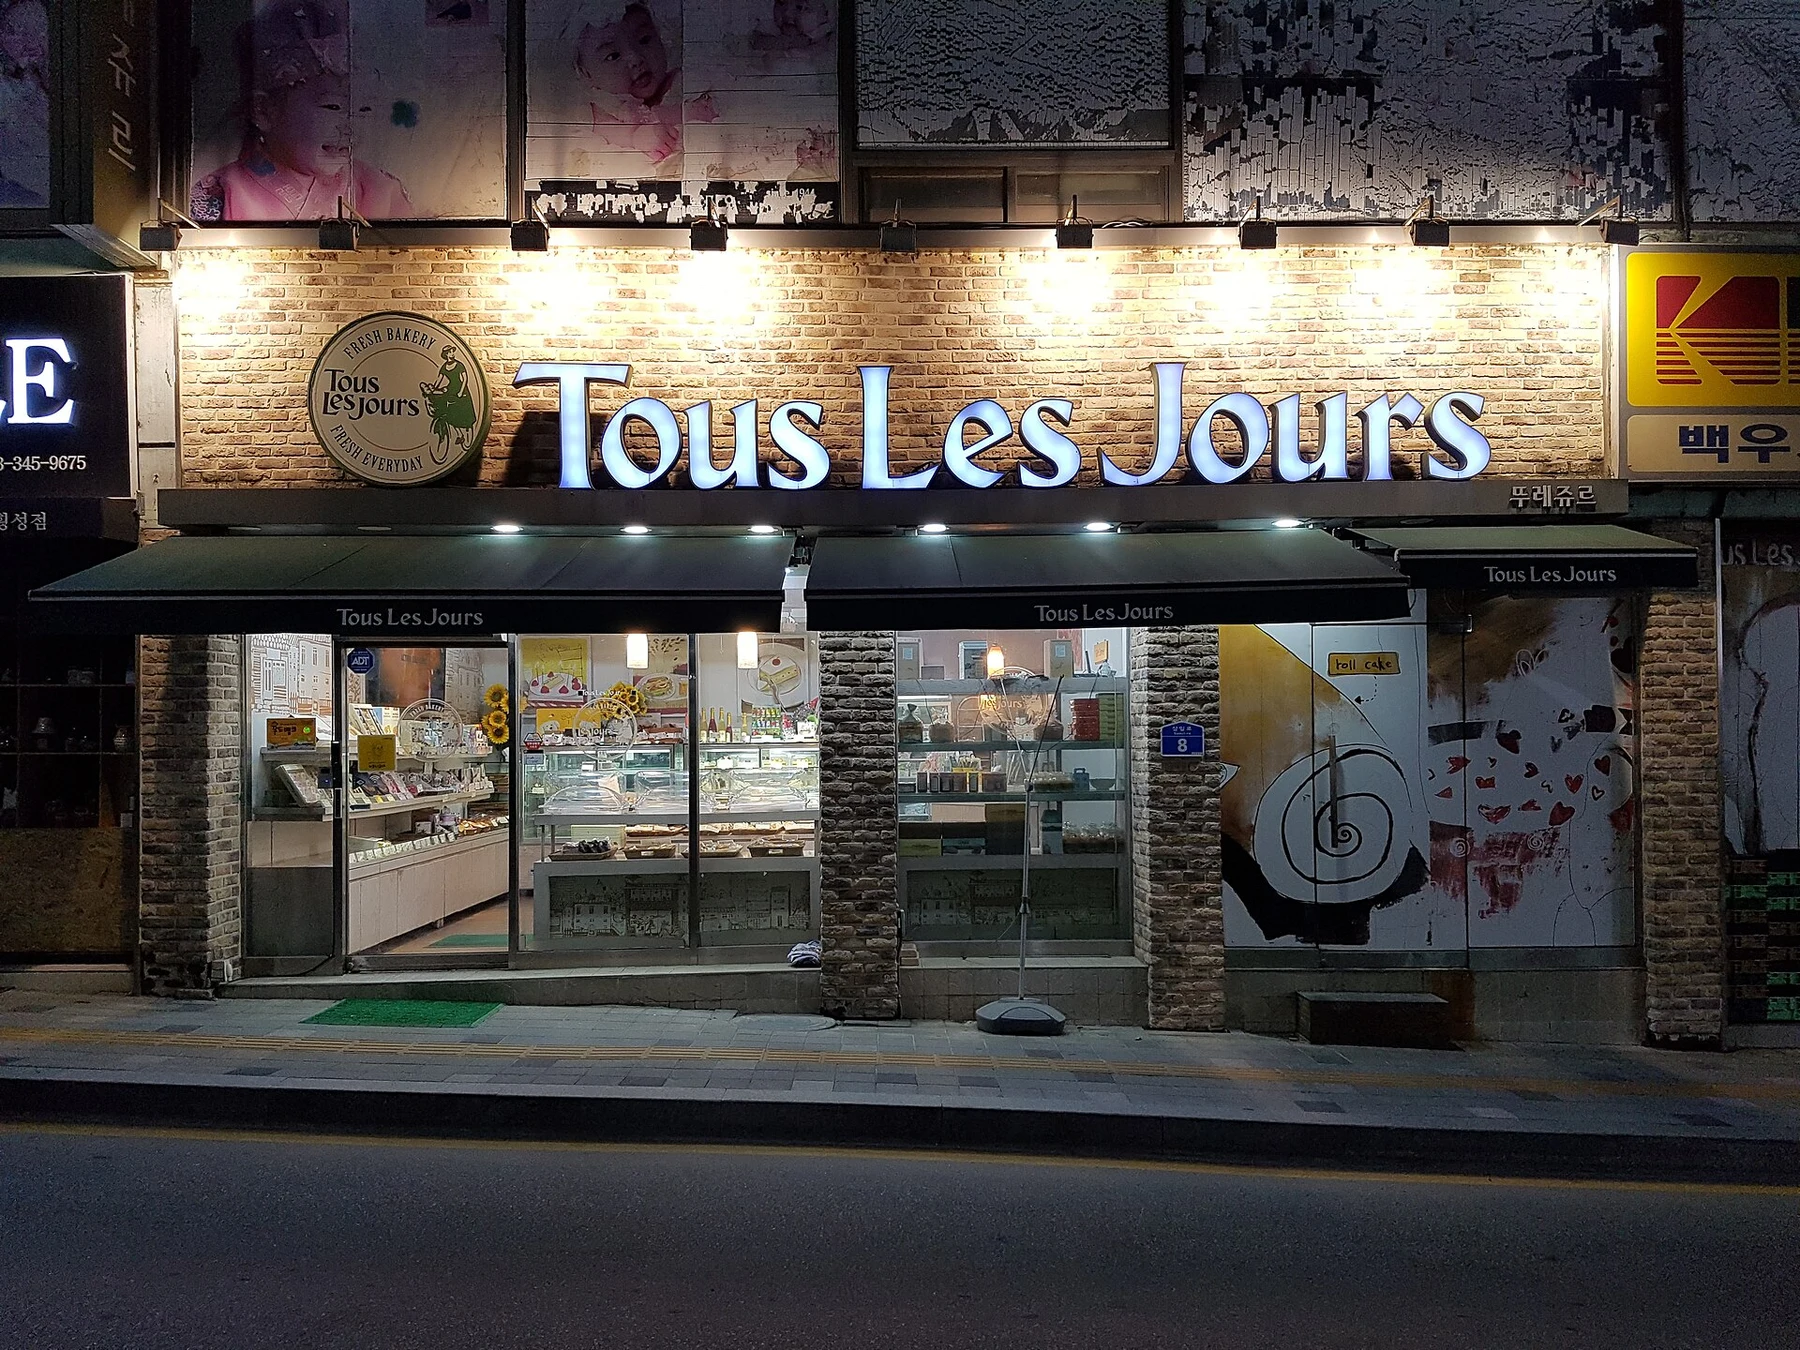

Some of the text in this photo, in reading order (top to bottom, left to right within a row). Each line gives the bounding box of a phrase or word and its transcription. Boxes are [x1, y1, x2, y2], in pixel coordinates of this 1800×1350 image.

[343, 328, 437, 360] FRESH BAKERY
[324, 368, 380, 393] Tous
[512, 361, 1492, 490] Tous Les Jours
[330, 424, 423, 473] FRESH EVERYDAY
[1678, 423, 1800, 464] 백우
[1509, 484, 1597, 508] 뚜레쥬르
[1751, 539, 1794, 567] Les
[1483, 565, 1617, 582] Tous Les Jours
[336, 607, 484, 626] Tous Les Jours
[1033, 602, 1174, 622] Tous Les Jours
[351, 656, 370, 666] ADT
[1335, 656, 1393, 671] roll cake
[1177, 738, 1188, 753] 8
